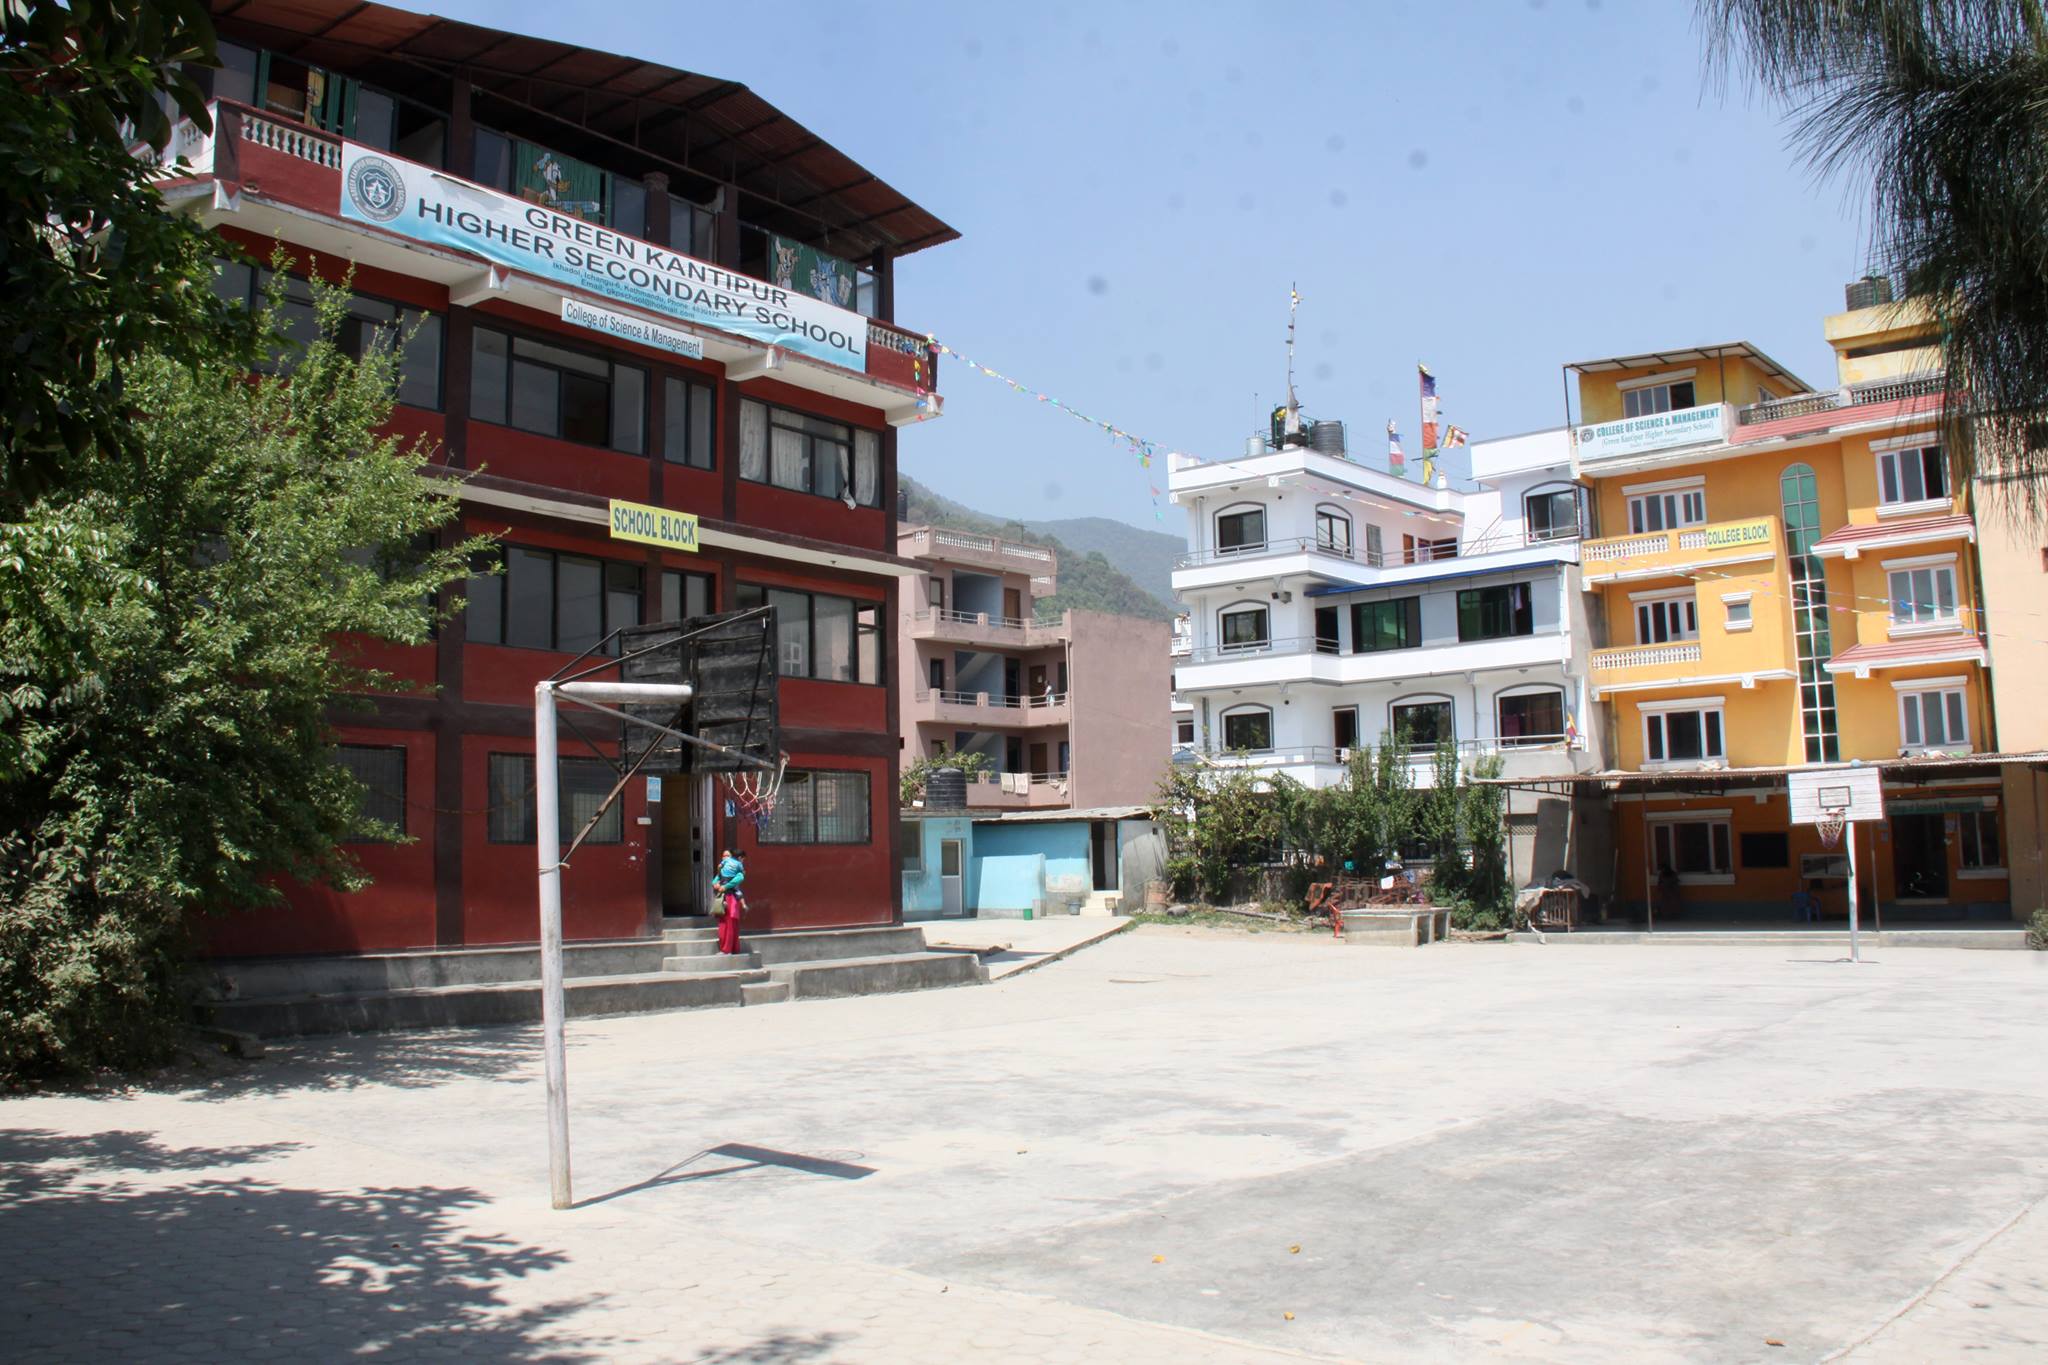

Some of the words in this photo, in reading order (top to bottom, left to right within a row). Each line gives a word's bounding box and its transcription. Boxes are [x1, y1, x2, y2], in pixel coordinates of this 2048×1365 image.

[418, 198, 554, 259] HIGHER
[565, 246, 747, 317] SECONDARY
[755, 306, 861, 355] SCHOOL
[525, 208, 635, 260] GREEN
[646, 248, 788, 308] KANTIPUR
[566, 303, 597, 328] College
[599, 314, 608, 325] of
[609, 316, 642, 339] Science
[643, 325, 650, 339] &
[651, 328, 700, 354] Management
[1596, 423, 1625, 438] COLLEGE
[1625, 422, 1634, 433] OF
[1635, 417, 1664, 431] SCIENCE
[1671, 407, 1719, 425] MANAGEMENT
[614, 507, 657, 538] SCHOOL
[661, 515, 695, 545] BLOCK
[1707, 528, 1741, 545] COLLEGE
[1742, 524, 1768, 541] BLOCK
